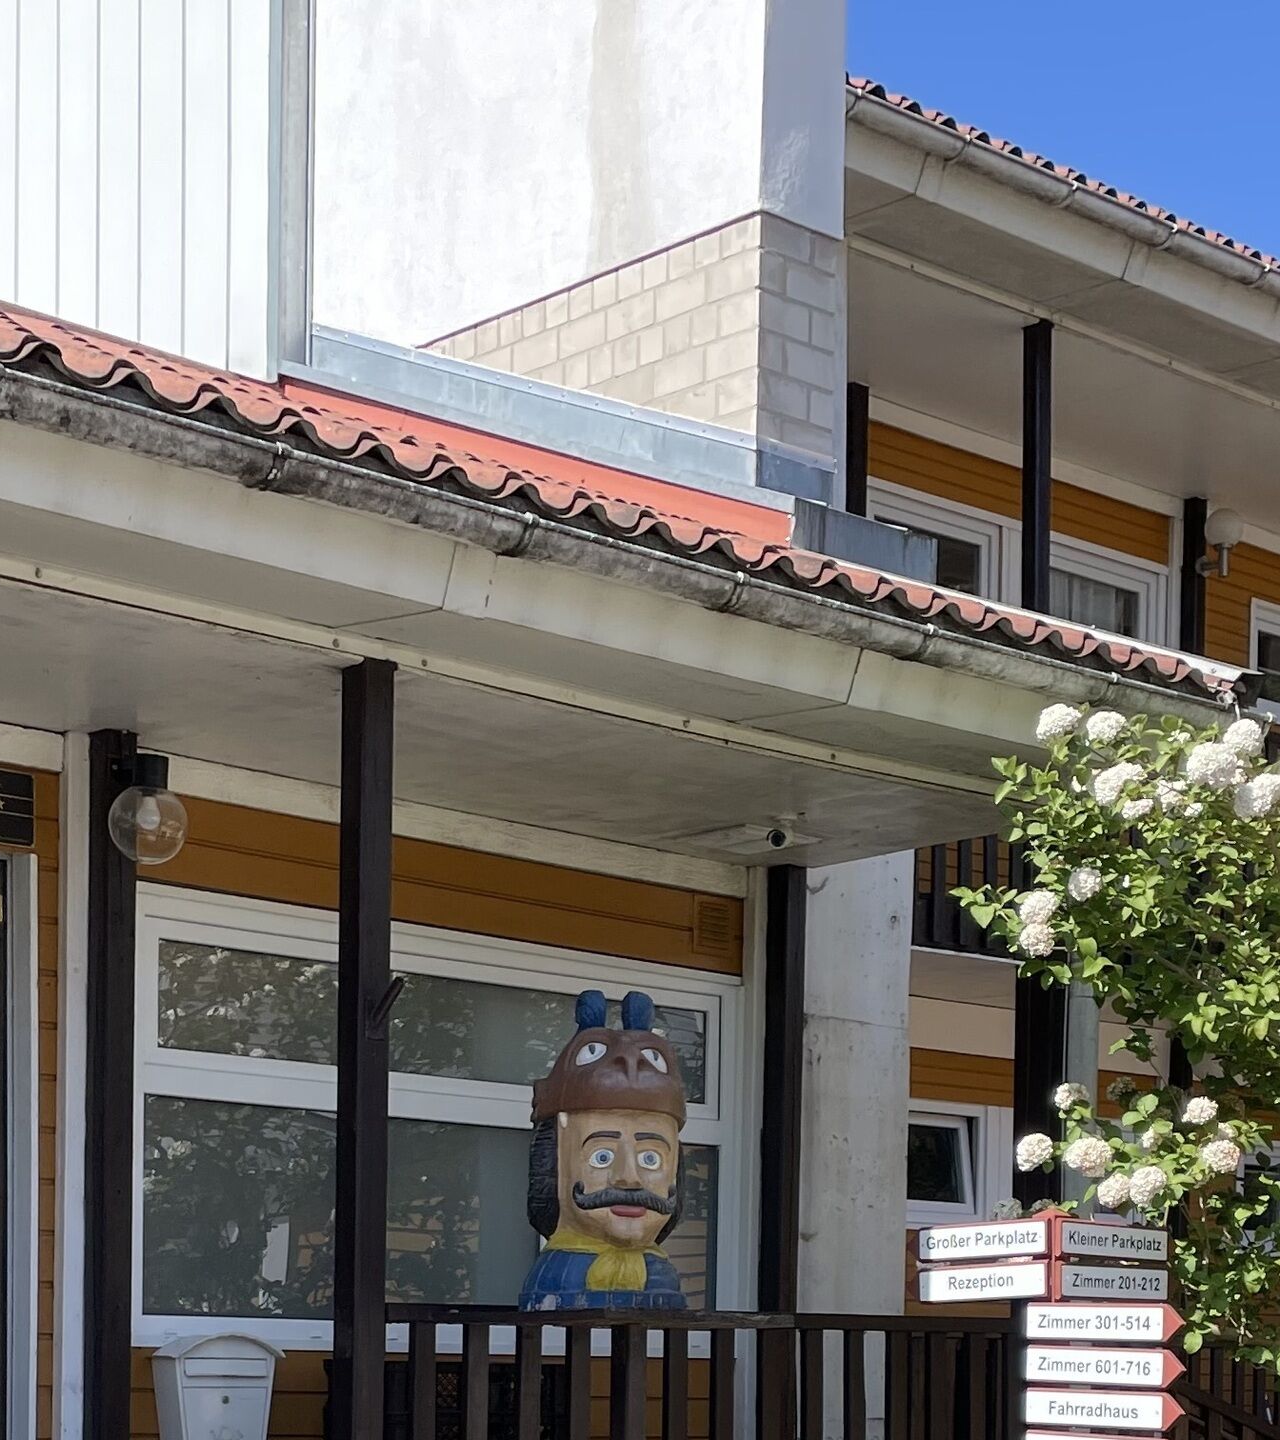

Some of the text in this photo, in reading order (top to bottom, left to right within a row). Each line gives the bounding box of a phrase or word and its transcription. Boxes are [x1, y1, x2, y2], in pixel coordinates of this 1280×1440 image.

[926, 1231, 1037, 1251] Großer Parkplatz
[1069, 1230, 1161, 1253] Kleiner Parkplatz
[949, 1274, 1013, 1291] Rezeption
[1072, 1273, 1160, 1292] Zimmer 201-212
[1038, 1314, 1151, 1330] Zimmer 301-514
[1038, 1357, 1151, 1375] Zimmer 601-716
[1049, 1401, 1138, 1418] Fahrradhaus
